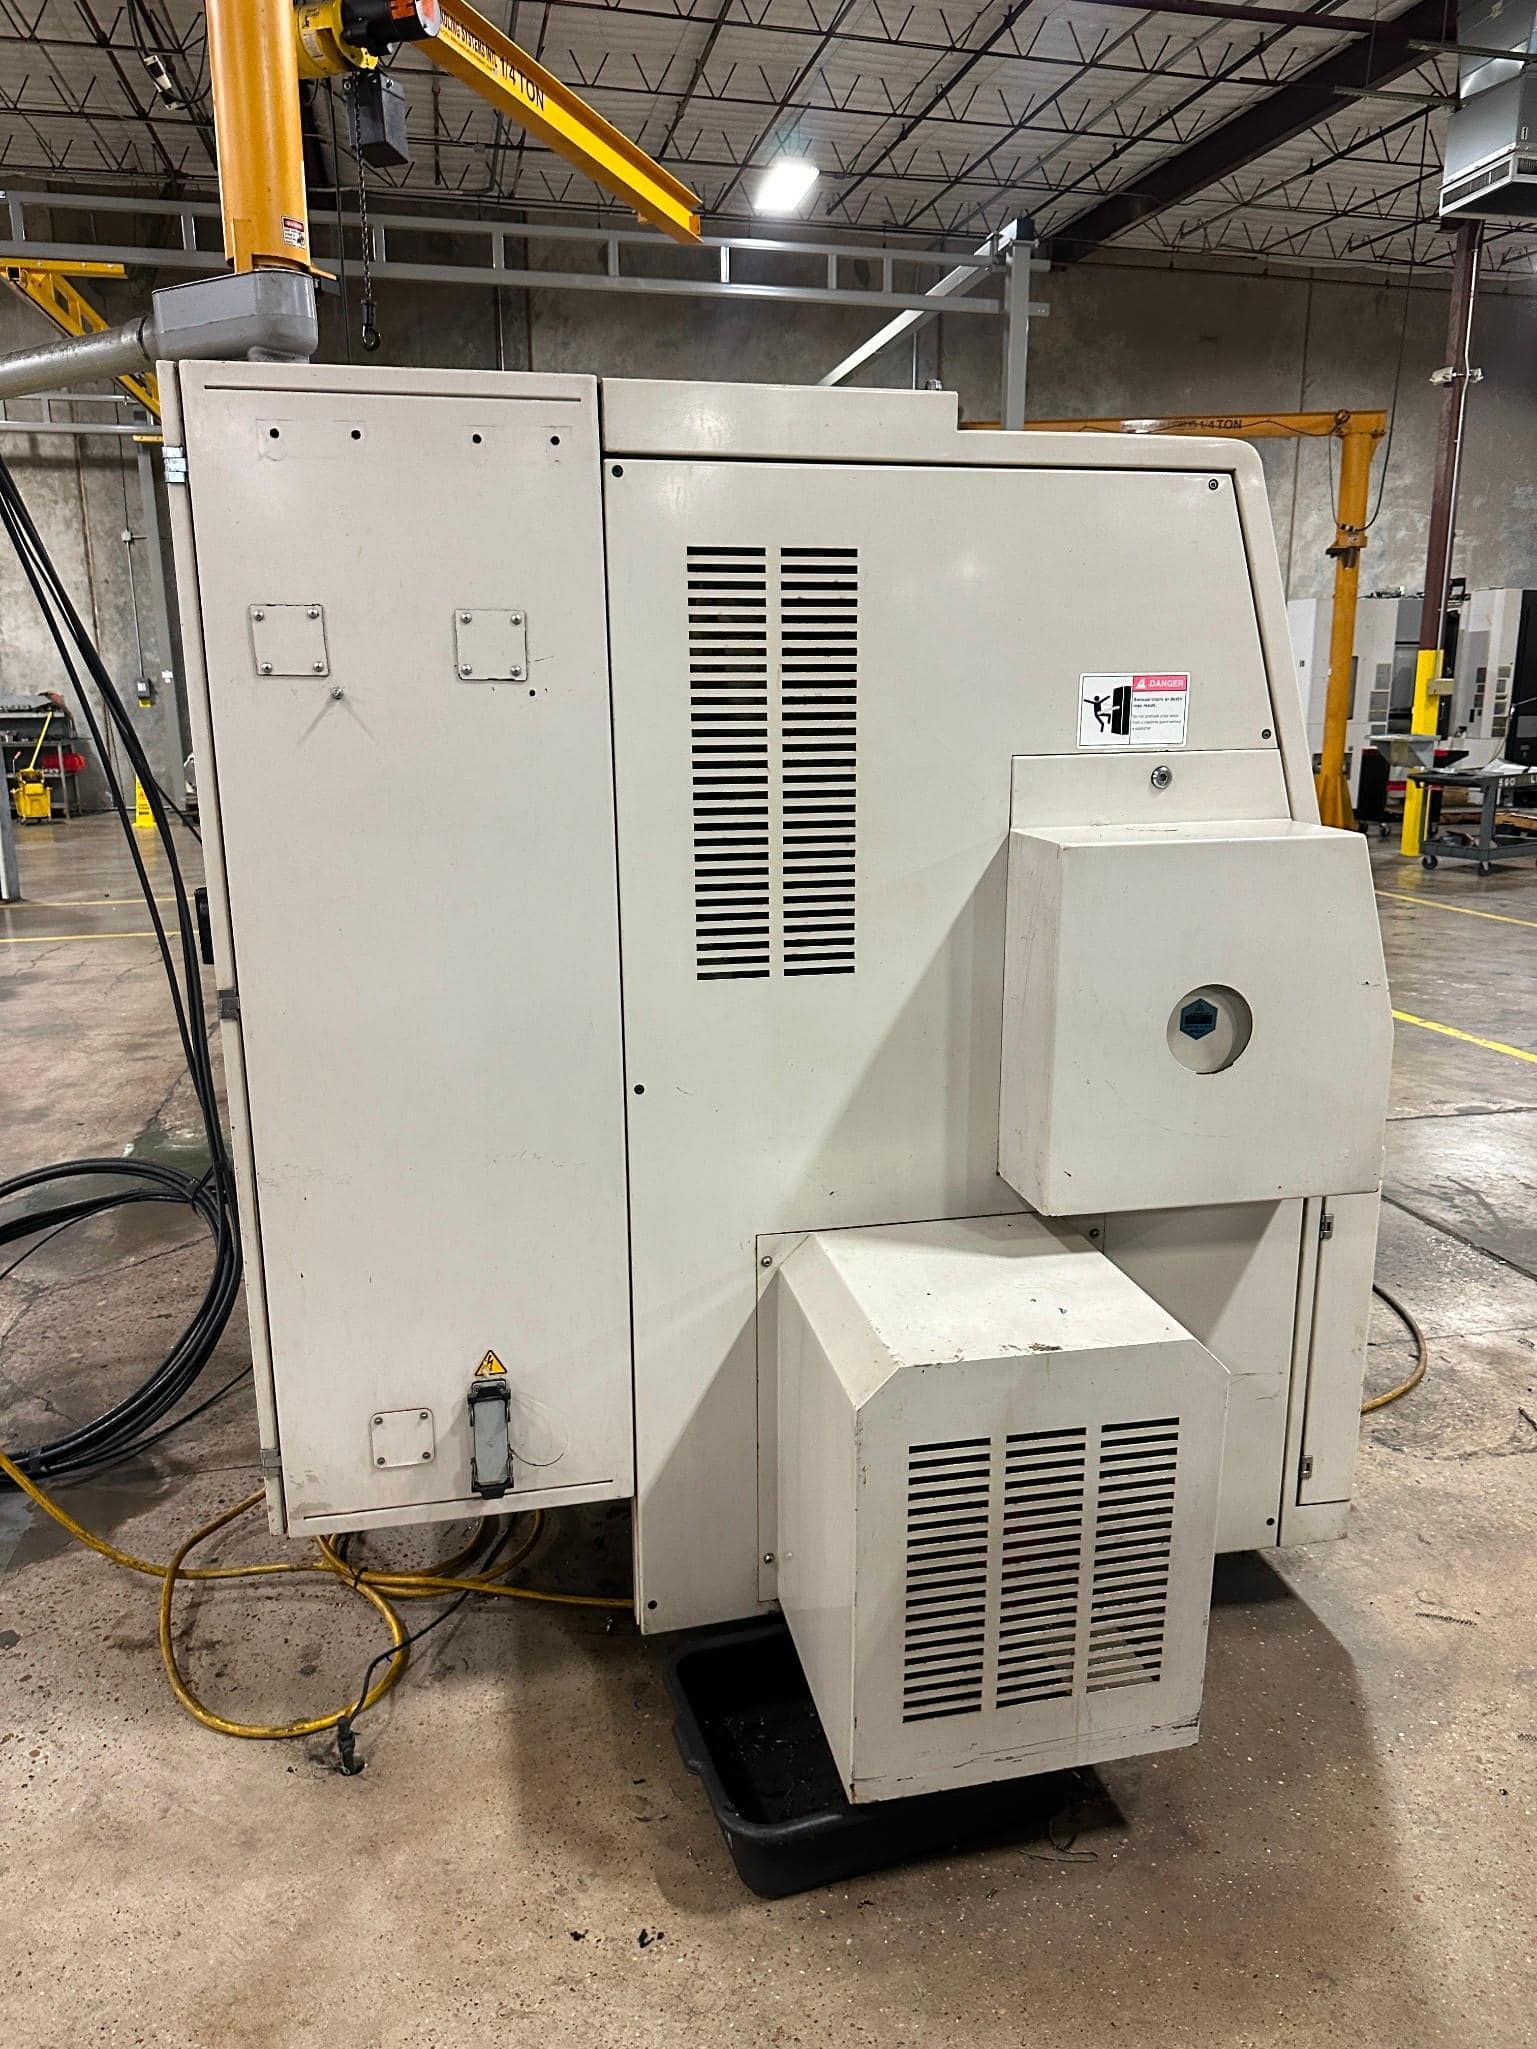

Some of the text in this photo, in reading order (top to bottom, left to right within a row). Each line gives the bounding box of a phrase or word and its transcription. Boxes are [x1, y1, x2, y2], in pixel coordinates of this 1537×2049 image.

[500, 56, 516, 86] 1/4
[517, 69, 544, 111] TON
[1216, 419, 1242, 429] TON
[1149, 679, 1184, 688] DANGER
